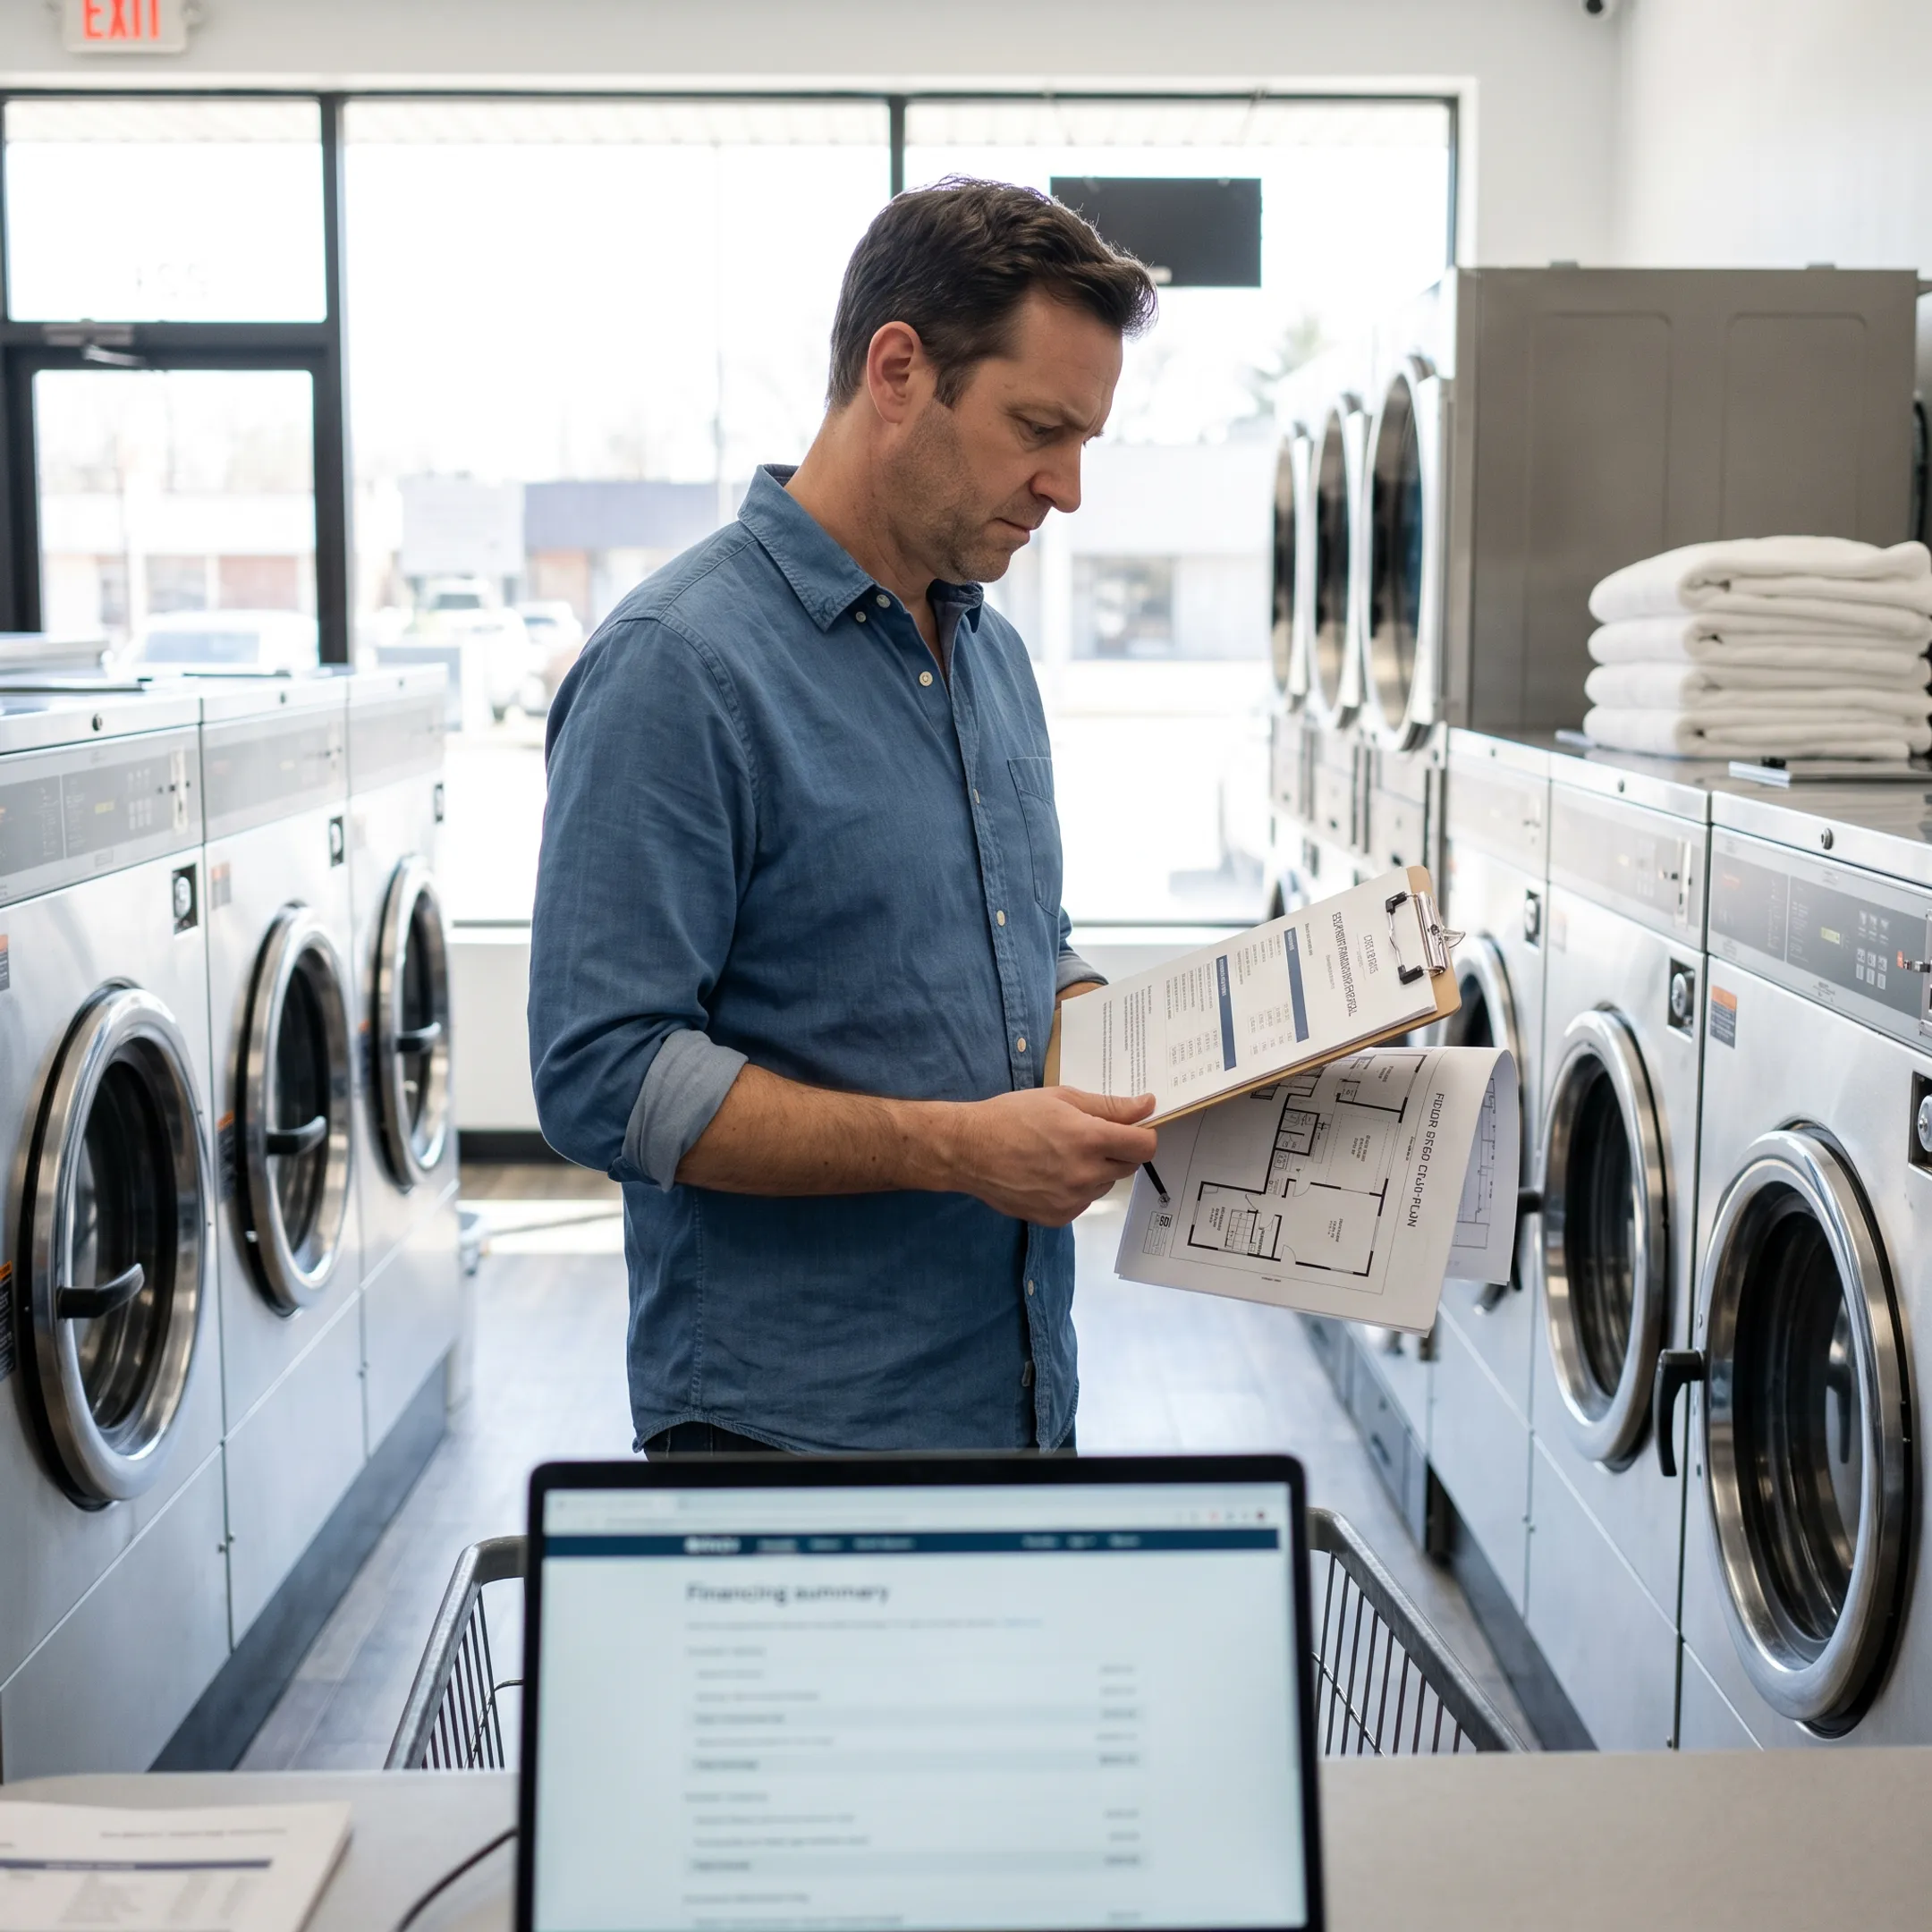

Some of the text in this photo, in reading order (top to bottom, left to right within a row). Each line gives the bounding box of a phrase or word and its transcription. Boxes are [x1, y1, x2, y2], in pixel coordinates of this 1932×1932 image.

[83, 0, 161, 39] EXIT
[686, 1582, 889, 1606] Financing summary
